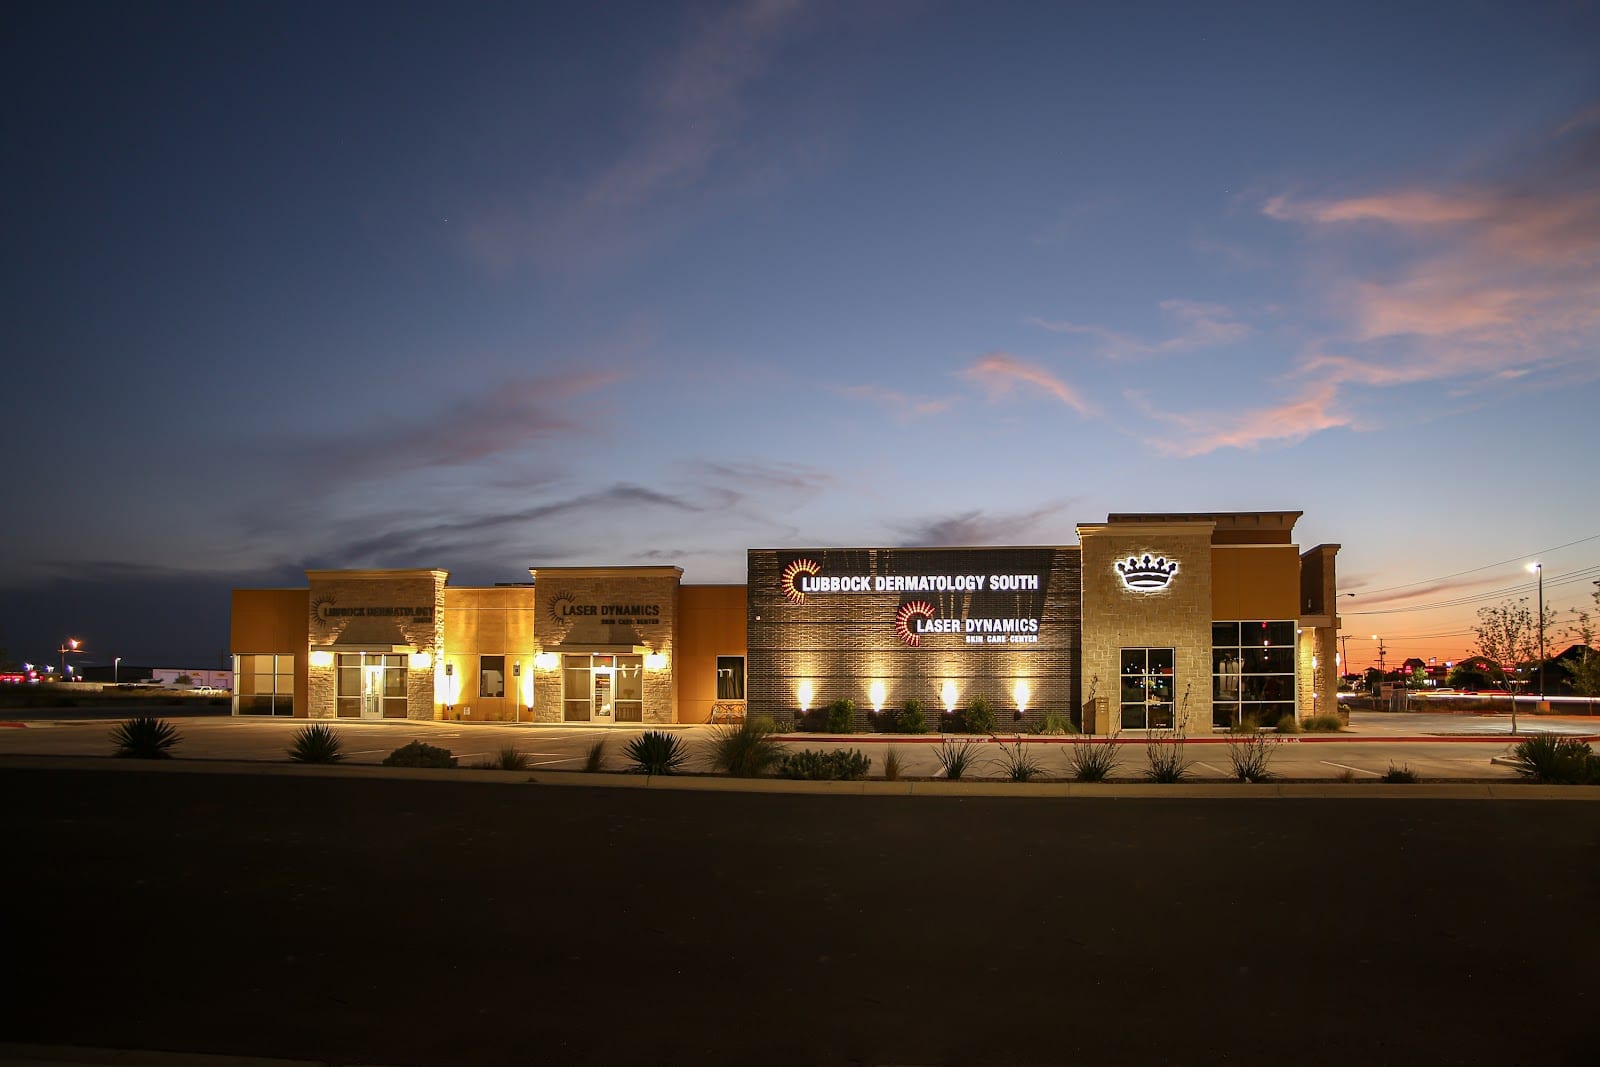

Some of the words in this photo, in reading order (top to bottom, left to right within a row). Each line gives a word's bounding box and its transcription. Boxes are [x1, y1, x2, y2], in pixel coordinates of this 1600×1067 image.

[802, 576, 871, 591] LUBBOCK
[875, 575, 985, 591] DERMATOLOGY
[990, 575, 1038, 590] SOUTH
[562, 605, 597, 616] LASER
[601, 605, 660, 616] DYNAMICS
[917, 619, 960, 632] LASER
[966, 619, 1038, 632] DYNAMICS
[966, 635, 983, 643] SKIN
[987, 635, 1006, 643] CARE
[1010, 635, 1038, 643] CENTER
